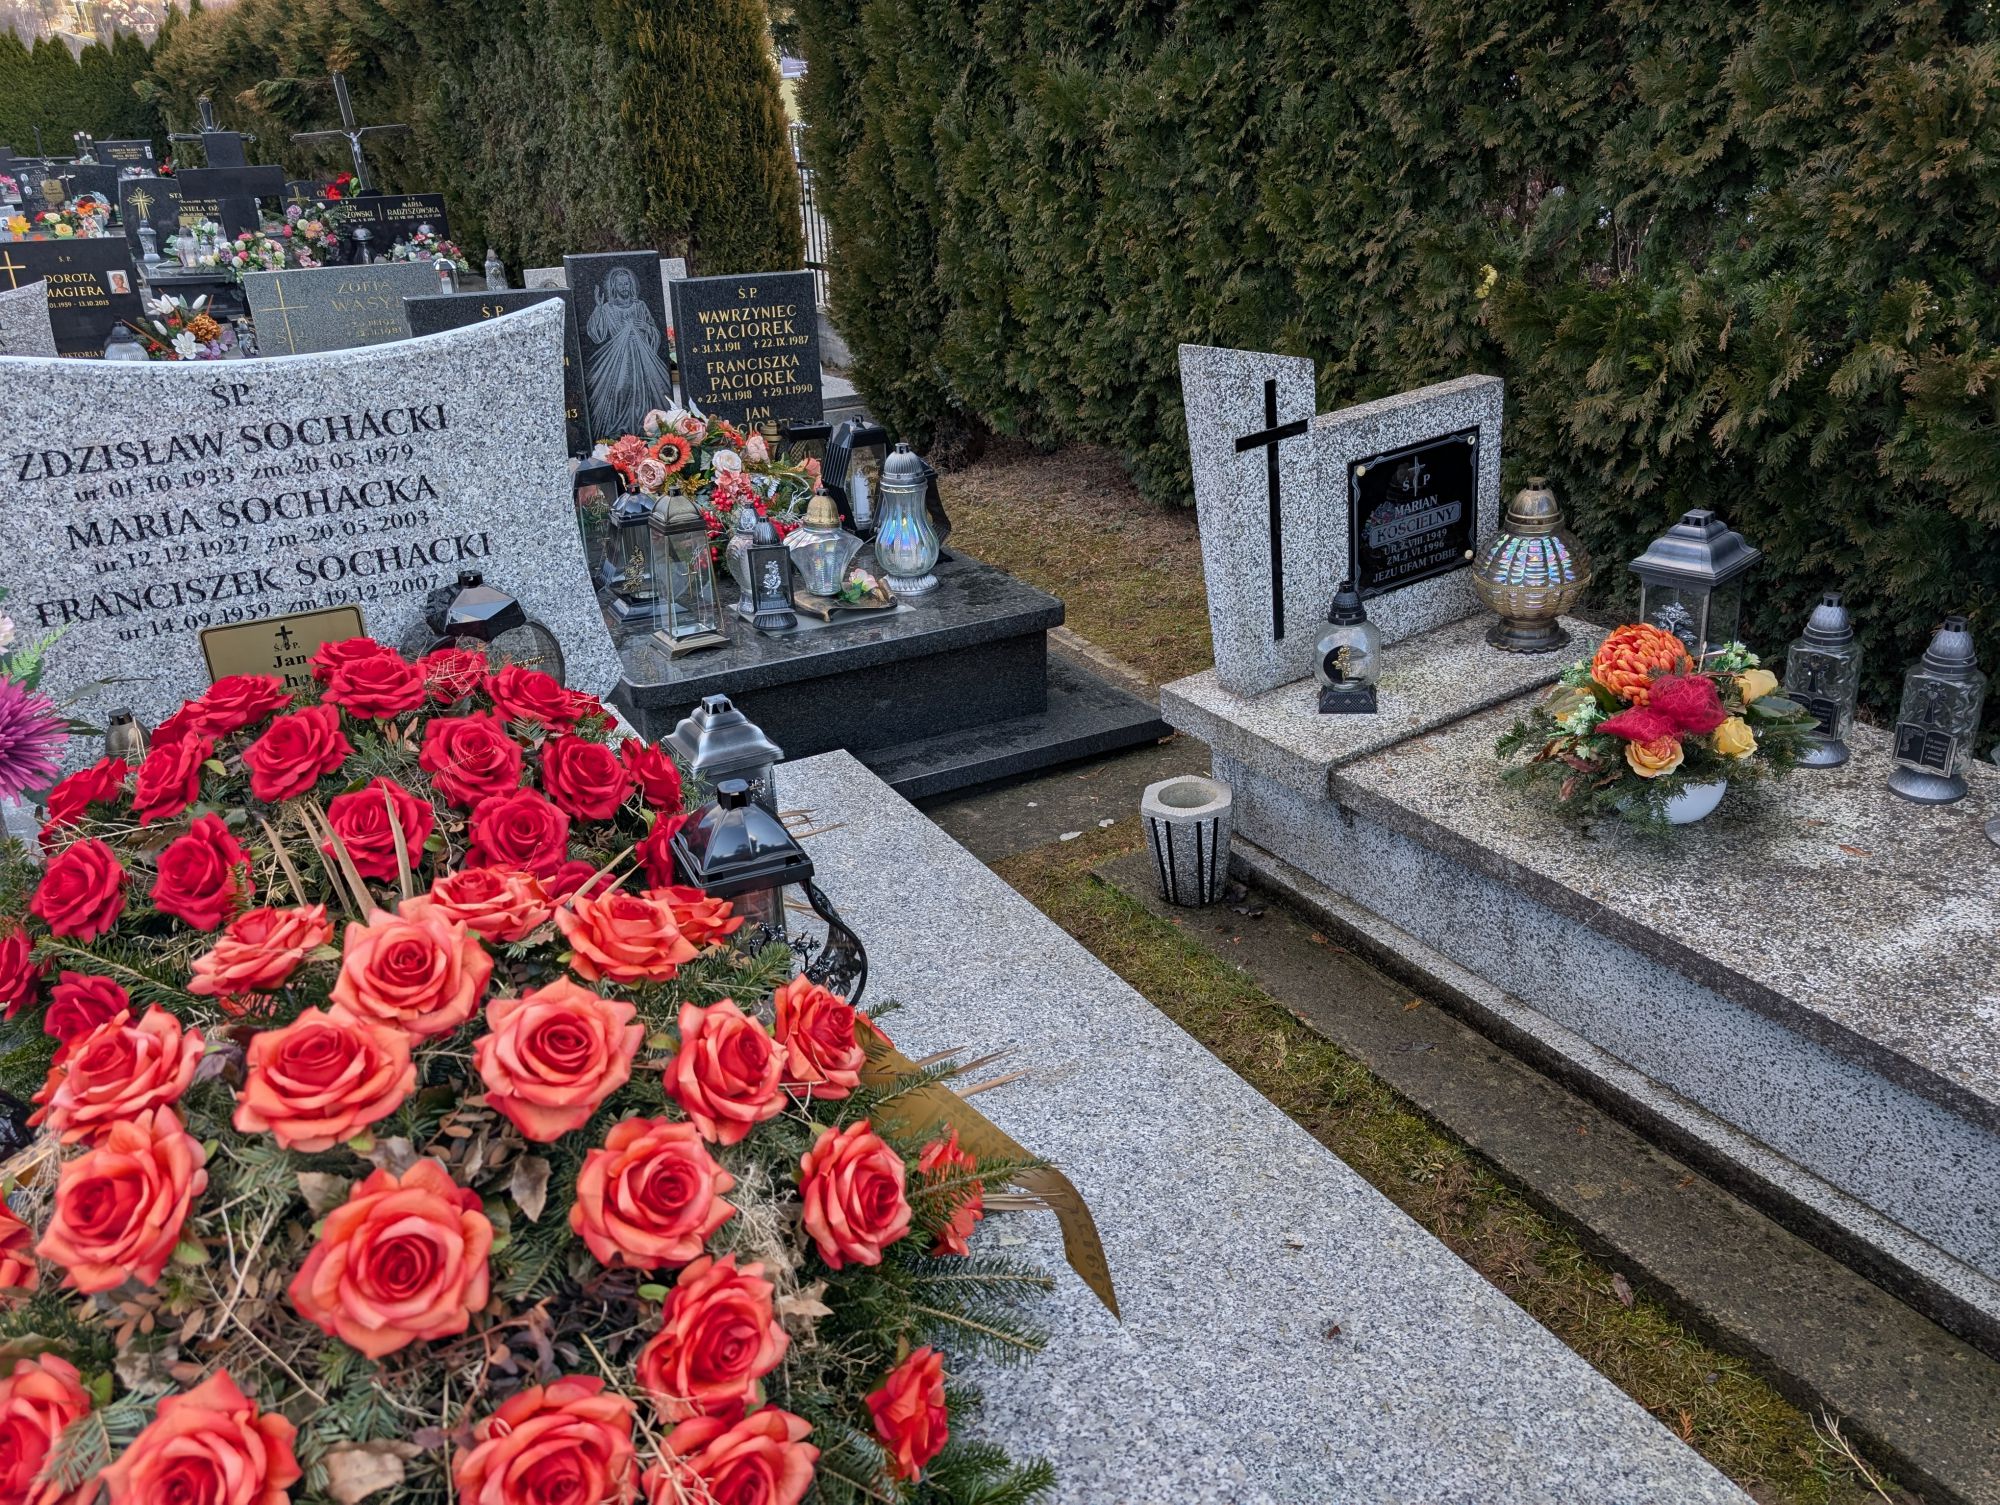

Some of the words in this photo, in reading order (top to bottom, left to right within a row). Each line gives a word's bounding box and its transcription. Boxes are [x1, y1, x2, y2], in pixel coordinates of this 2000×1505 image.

[44, 273, 97, 284] DOROTA
[46, 286, 105, 298] MAGIERA
[697, 304, 798, 325] WAWRZYNIEC
[705, 320, 796, 341] PACIOREK
[706, 354, 801, 375] FRANCISZKA
[710, 369, 798, 391] PACIOREK
[745, 405, 771, 422] JAN
[13, 430, 225, 483] ZDZISŁAW
[239, 403, 450, 454] SOCHACKI
[65, 507, 207, 552] MARIA
[217, 474, 440, 530] SOCHACKA
[1394, 494, 1439, 517] MARIAN
[1372, 566, 1398, 583] JEZU
[1399, 557, 1427, 574] UFAM
[1429, 547, 1458, 564] TOBIE
[36, 566, 285, 629] FRANCISZEK
[295, 531, 493, 587] SOCHACKI
[272, 653, 308, 669] Jan
